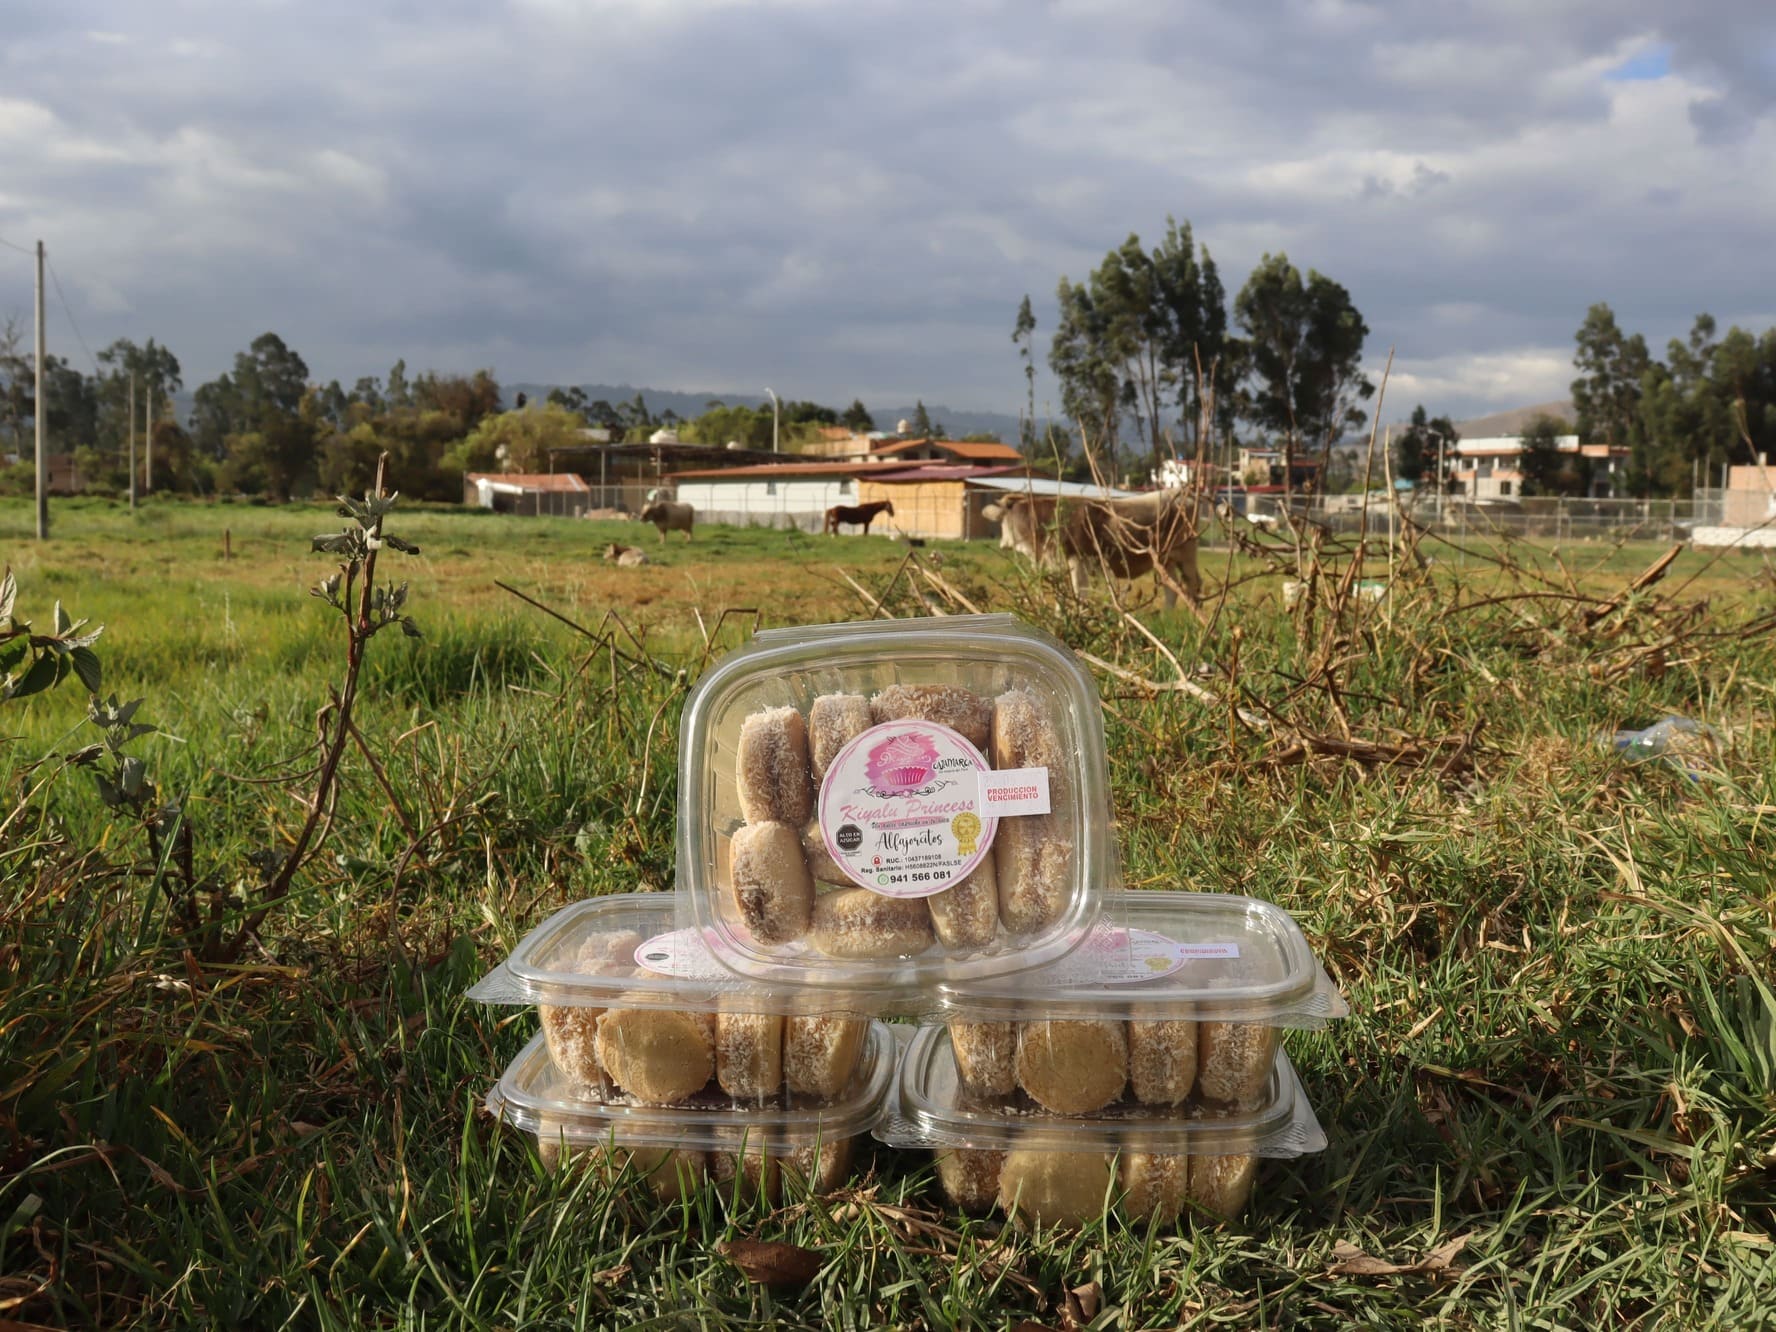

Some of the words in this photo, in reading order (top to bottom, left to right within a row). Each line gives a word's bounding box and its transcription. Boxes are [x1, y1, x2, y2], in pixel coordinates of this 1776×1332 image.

[987, 786, 1037, 795] PRODUCCION
[987, 793, 1039, 801] VENCIMIENTO
[839, 802, 898, 822] Kiyalu
[904, 799, 975, 818] Princess
[890, 874, 908, 883] 941
[912, 873, 931, 881] 566
[933, 871, 951, 880] 081
